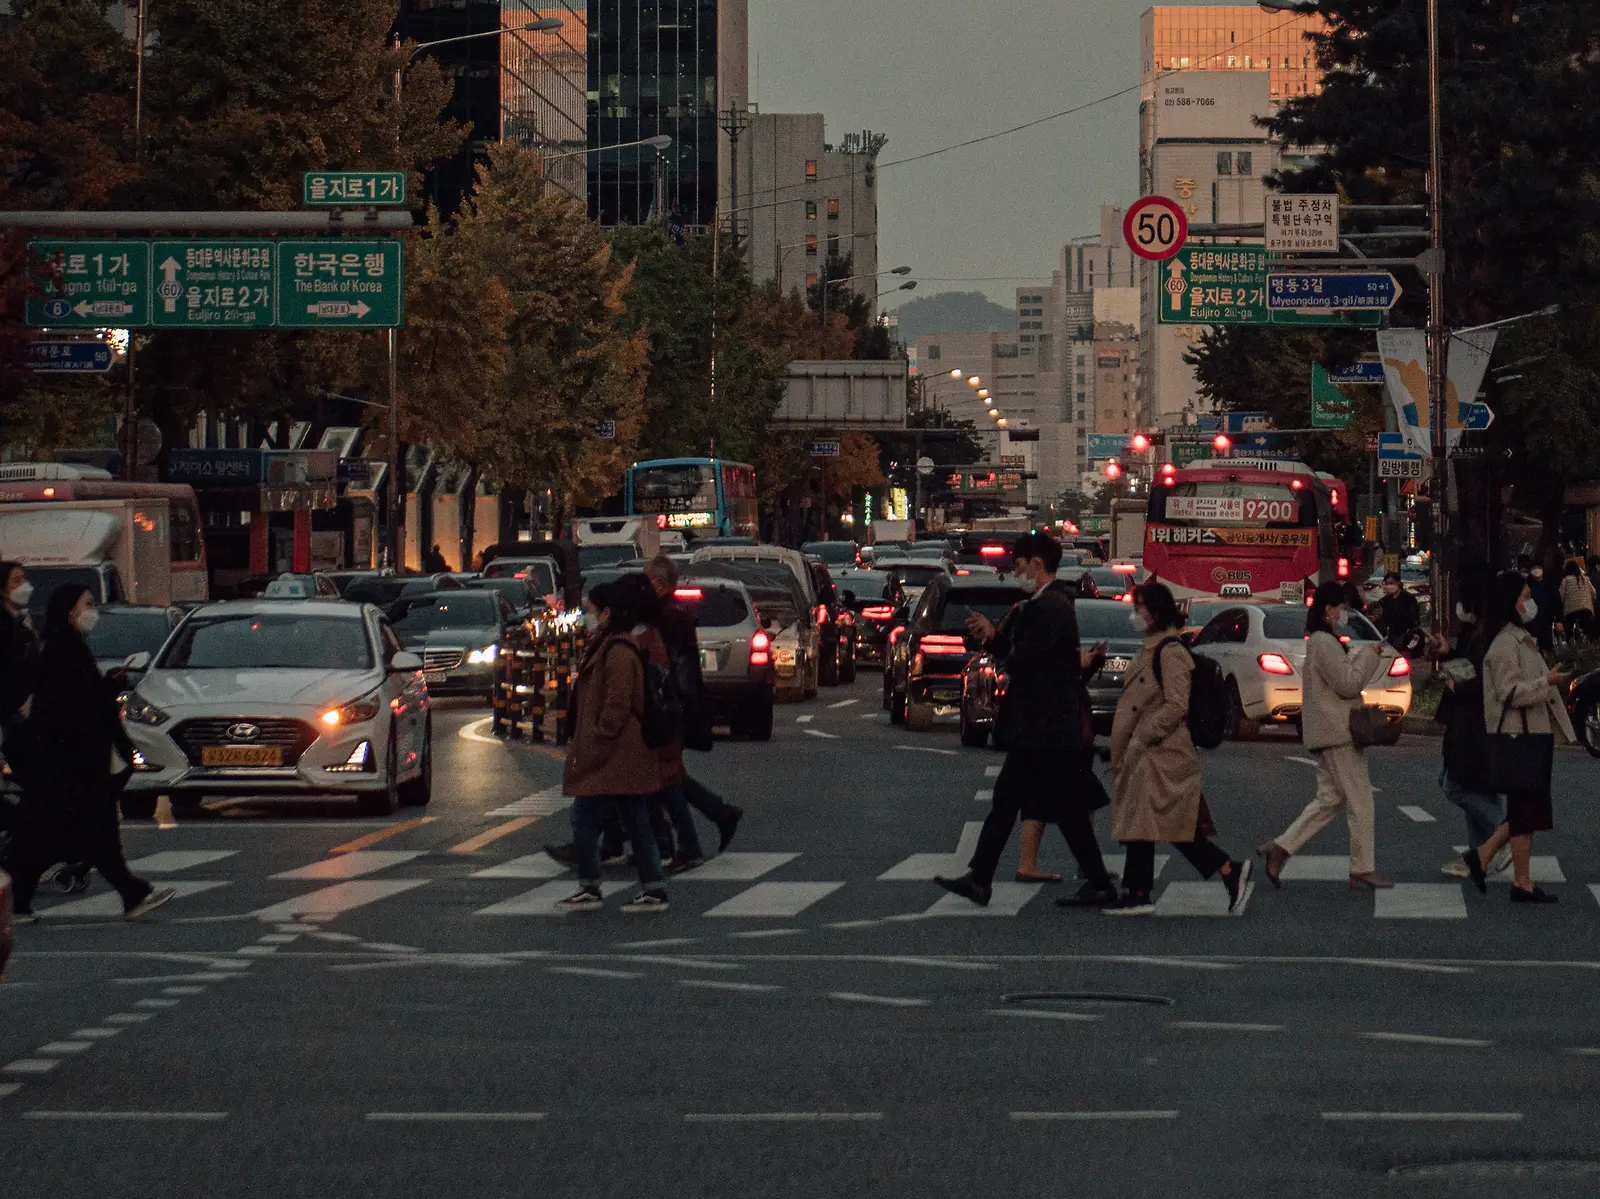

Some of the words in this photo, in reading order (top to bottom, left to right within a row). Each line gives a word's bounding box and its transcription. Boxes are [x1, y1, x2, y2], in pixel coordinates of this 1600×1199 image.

[310, 177, 398, 200] 을지로1가
[1272, 199, 1292, 212] 불법
[1272, 213, 1332, 226] 특별단속구역
[1138, 213, 1175, 245] 50
[186, 247, 270, 269] 동대문역사문화공원
[294, 252, 385, 277] 한국은행
[1190, 252, 1265, 271] 동대문역사문화공원
[163, 284, 178, 296] 60
[294, 279, 313, 292] The
[314, 279, 338, 292] Bank
[340, 279, 350, 292] of
[351, 279, 382, 292] Korea
[1170, 280, 1183, 291] 60
[1271, 278, 1323, 293] 명동3길
[186, 286, 269, 309] 을지로2가
[1189, 286, 1265, 307] 을지로2가
[1272, 296, 1331, 307] Myeongdong
[188, 309, 221, 323] Euljiro
[1190, 307, 1221, 320] Euljiro
[1382, 460, 1420, 476] 일방통행
[1245, 500, 1292, 520] 9200
[1151, 527, 1170, 543] 1위
[1173, 527, 1216, 544] 해커스
[1228, 570, 1252, 580] BUS
[1225, 587, 1247, 595] TAXI
